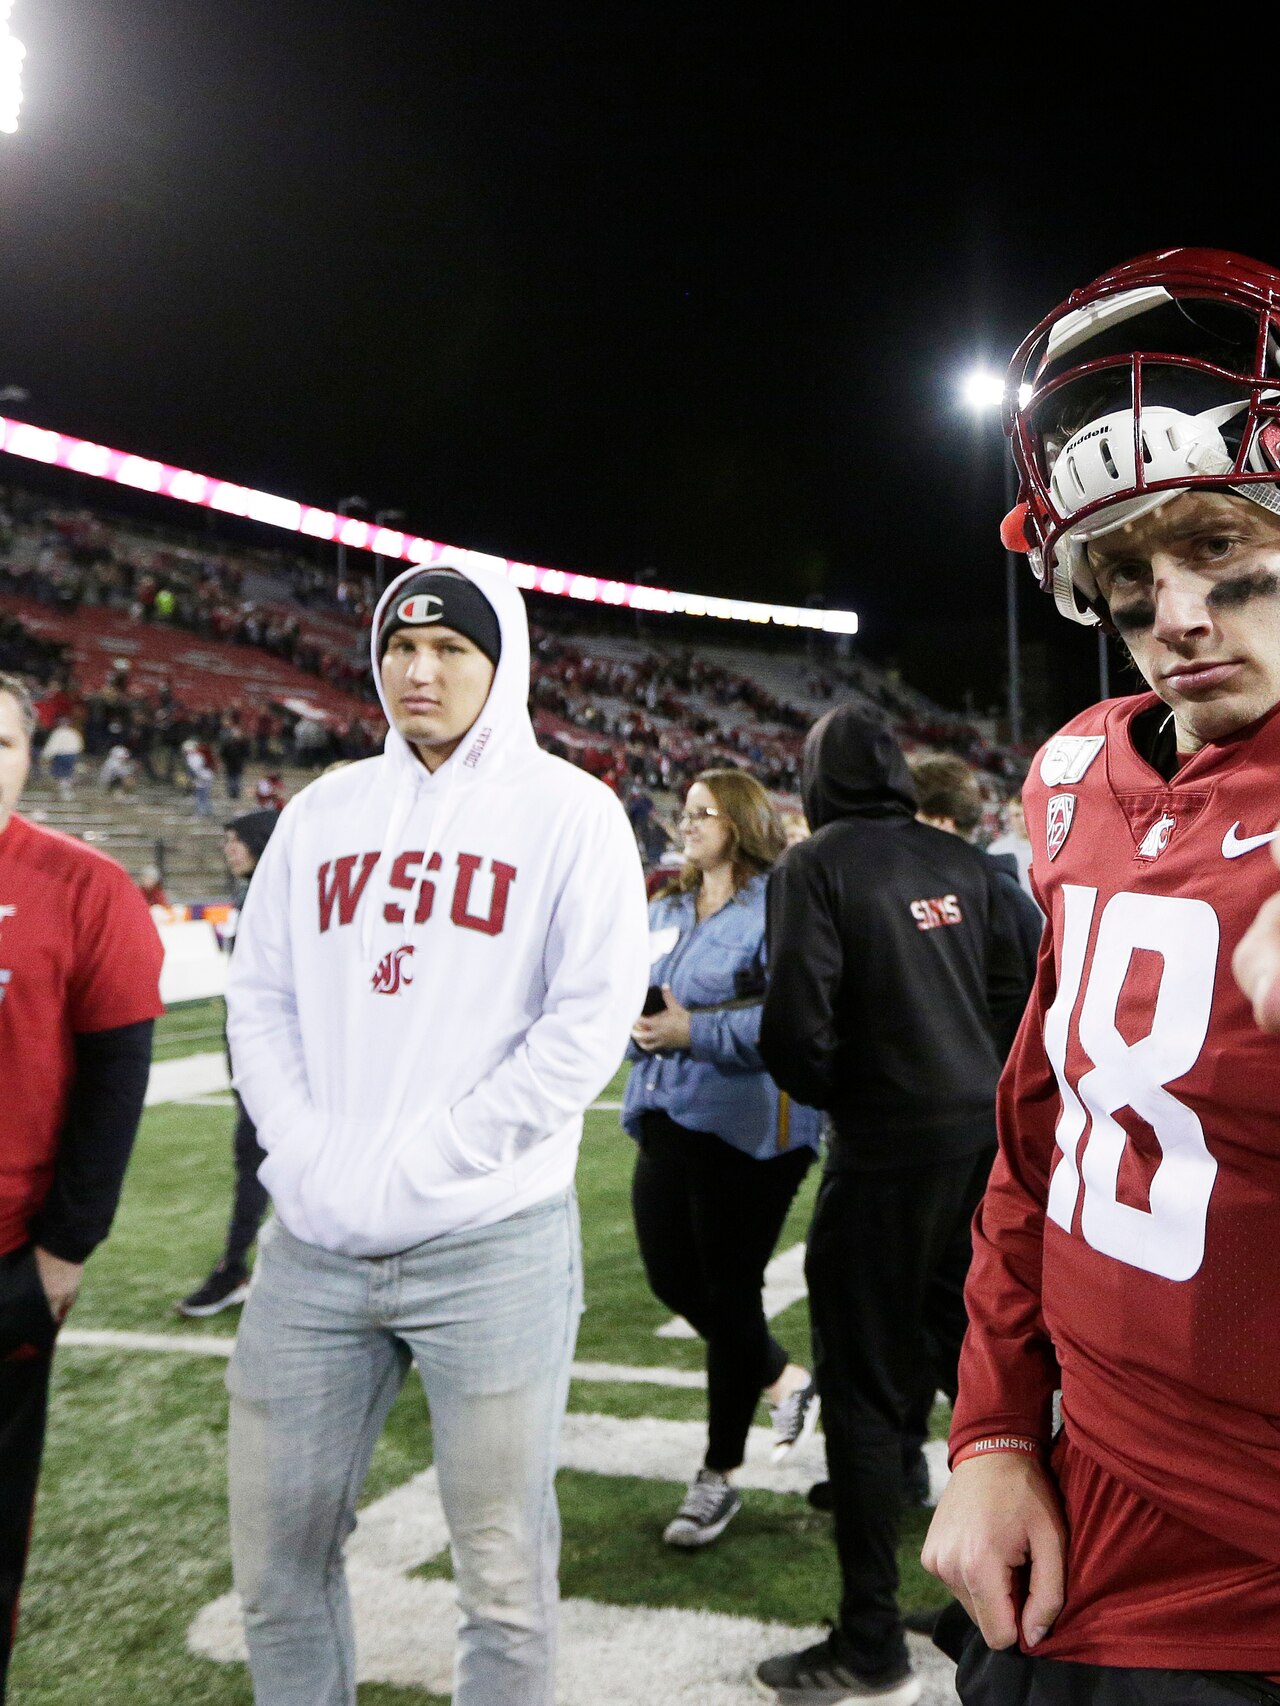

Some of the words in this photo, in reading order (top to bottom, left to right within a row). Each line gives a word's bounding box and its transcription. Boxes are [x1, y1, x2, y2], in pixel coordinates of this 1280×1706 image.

[1066, 425, 1109, 454] Riddell
[317, 850, 518, 936] WSU
[1043, 882, 1220, 1282] 18
